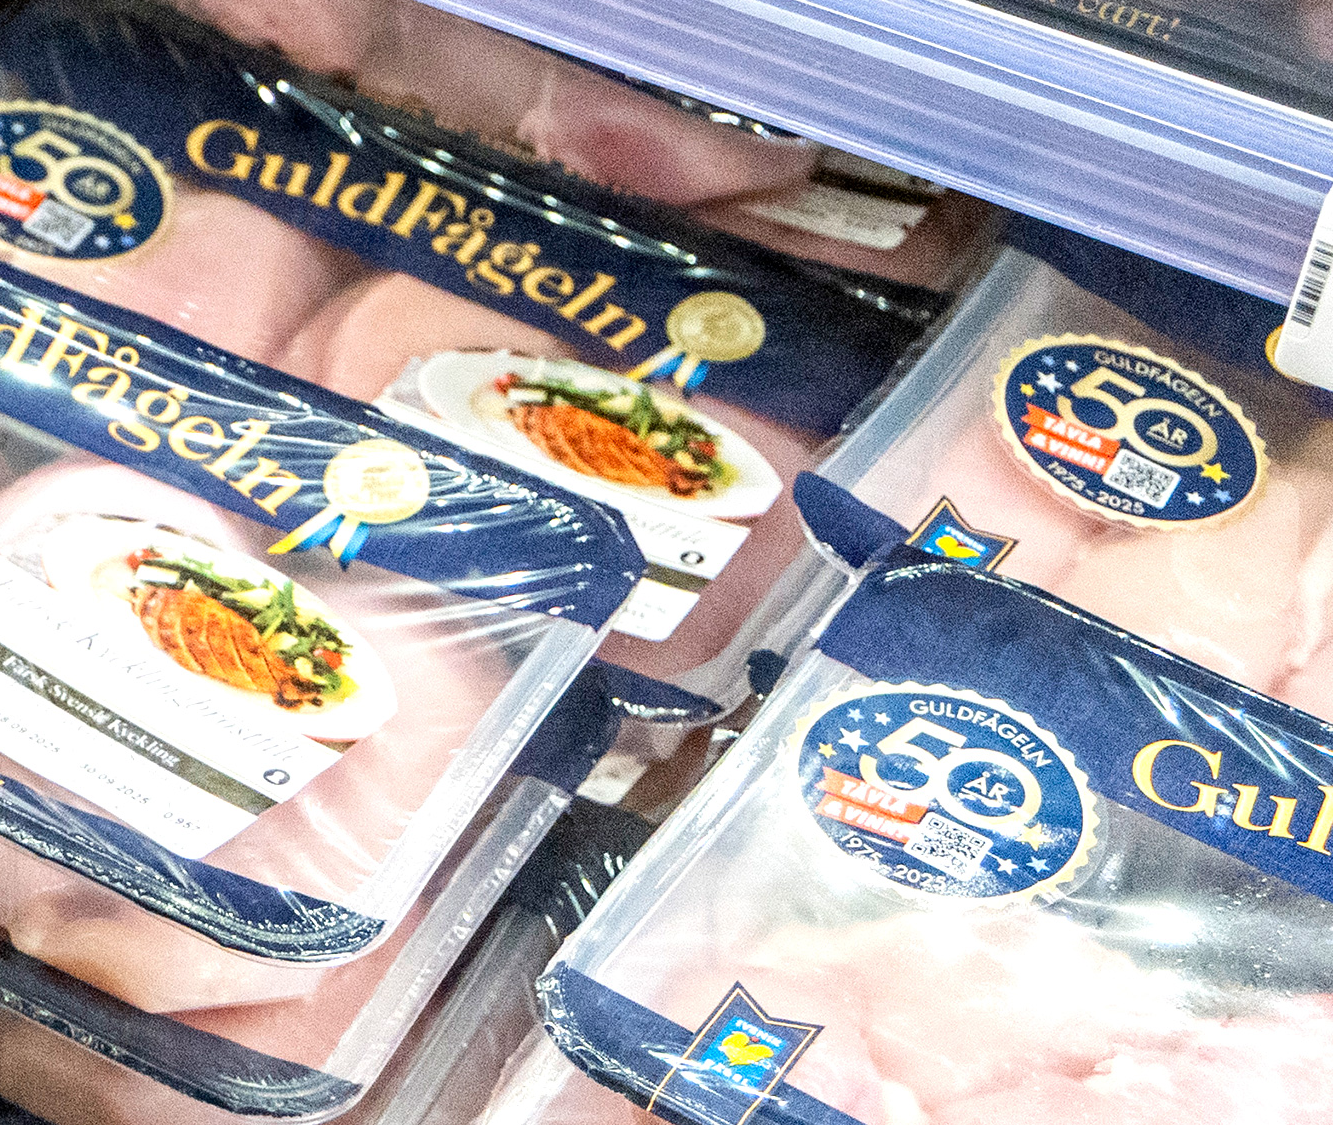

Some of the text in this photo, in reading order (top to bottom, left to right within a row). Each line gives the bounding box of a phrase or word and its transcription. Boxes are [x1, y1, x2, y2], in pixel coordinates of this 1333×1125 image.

[185, 115, 651, 356] GuldFågeln
[1056, 366, 1219, 468] 50
[1093, 349, 1224, 419] GULDFÅGELN
[1147, 418, 1188, 447] ÅR
[47, 678, 109, 724] Svensk
[108, 715, 182, 770] Kyckling
[908, 697, 1054, 770] GULDFÅGELN
[859, 715, 1043, 825] 50
[965, 763, 1010, 799] ÅR
